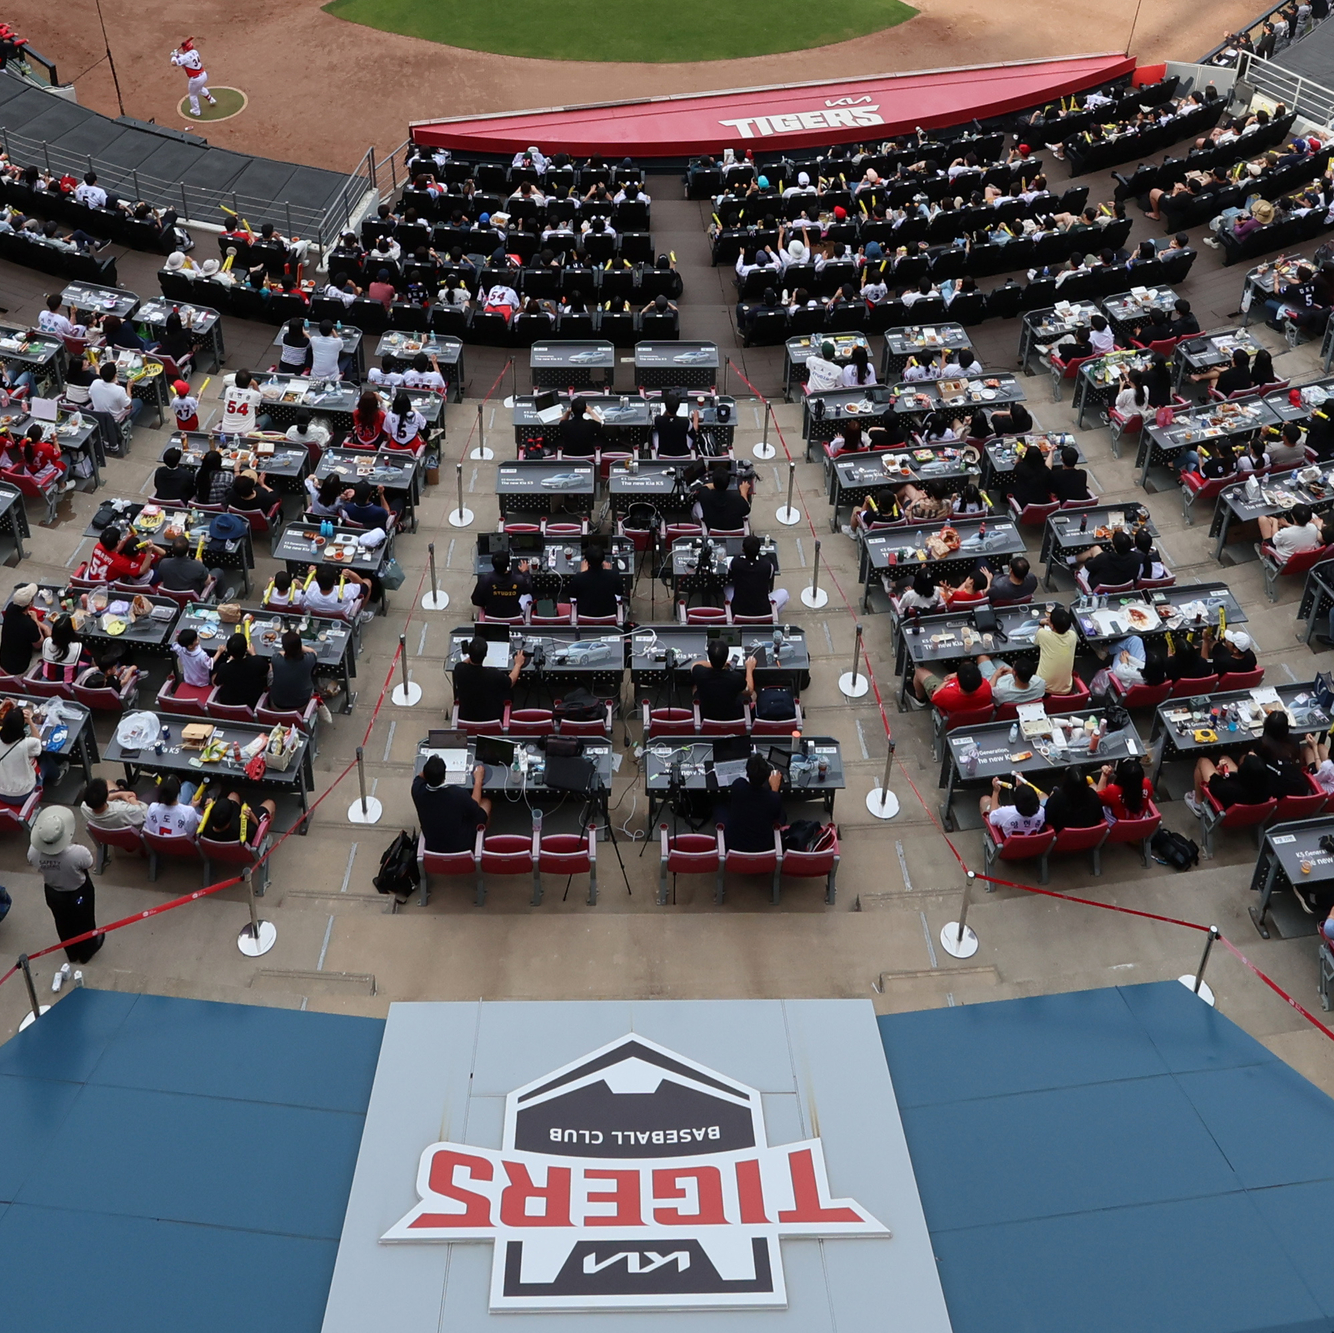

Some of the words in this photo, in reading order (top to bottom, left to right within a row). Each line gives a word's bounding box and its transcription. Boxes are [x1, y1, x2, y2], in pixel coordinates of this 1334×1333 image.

[717, 103, 888, 141] TIGERS
[489, 290, 506, 302] 54
[176, 408, 191, 418] 47
[227, 400, 249, 416] 54
[397, 424, 408, 438] 5
[89, 560, 109, 581] 54
[548, 1127, 605, 1145] CLUB
[610, 1125, 722, 1146] BASEBALL
[405, 1147, 867, 1230] TIGERS
